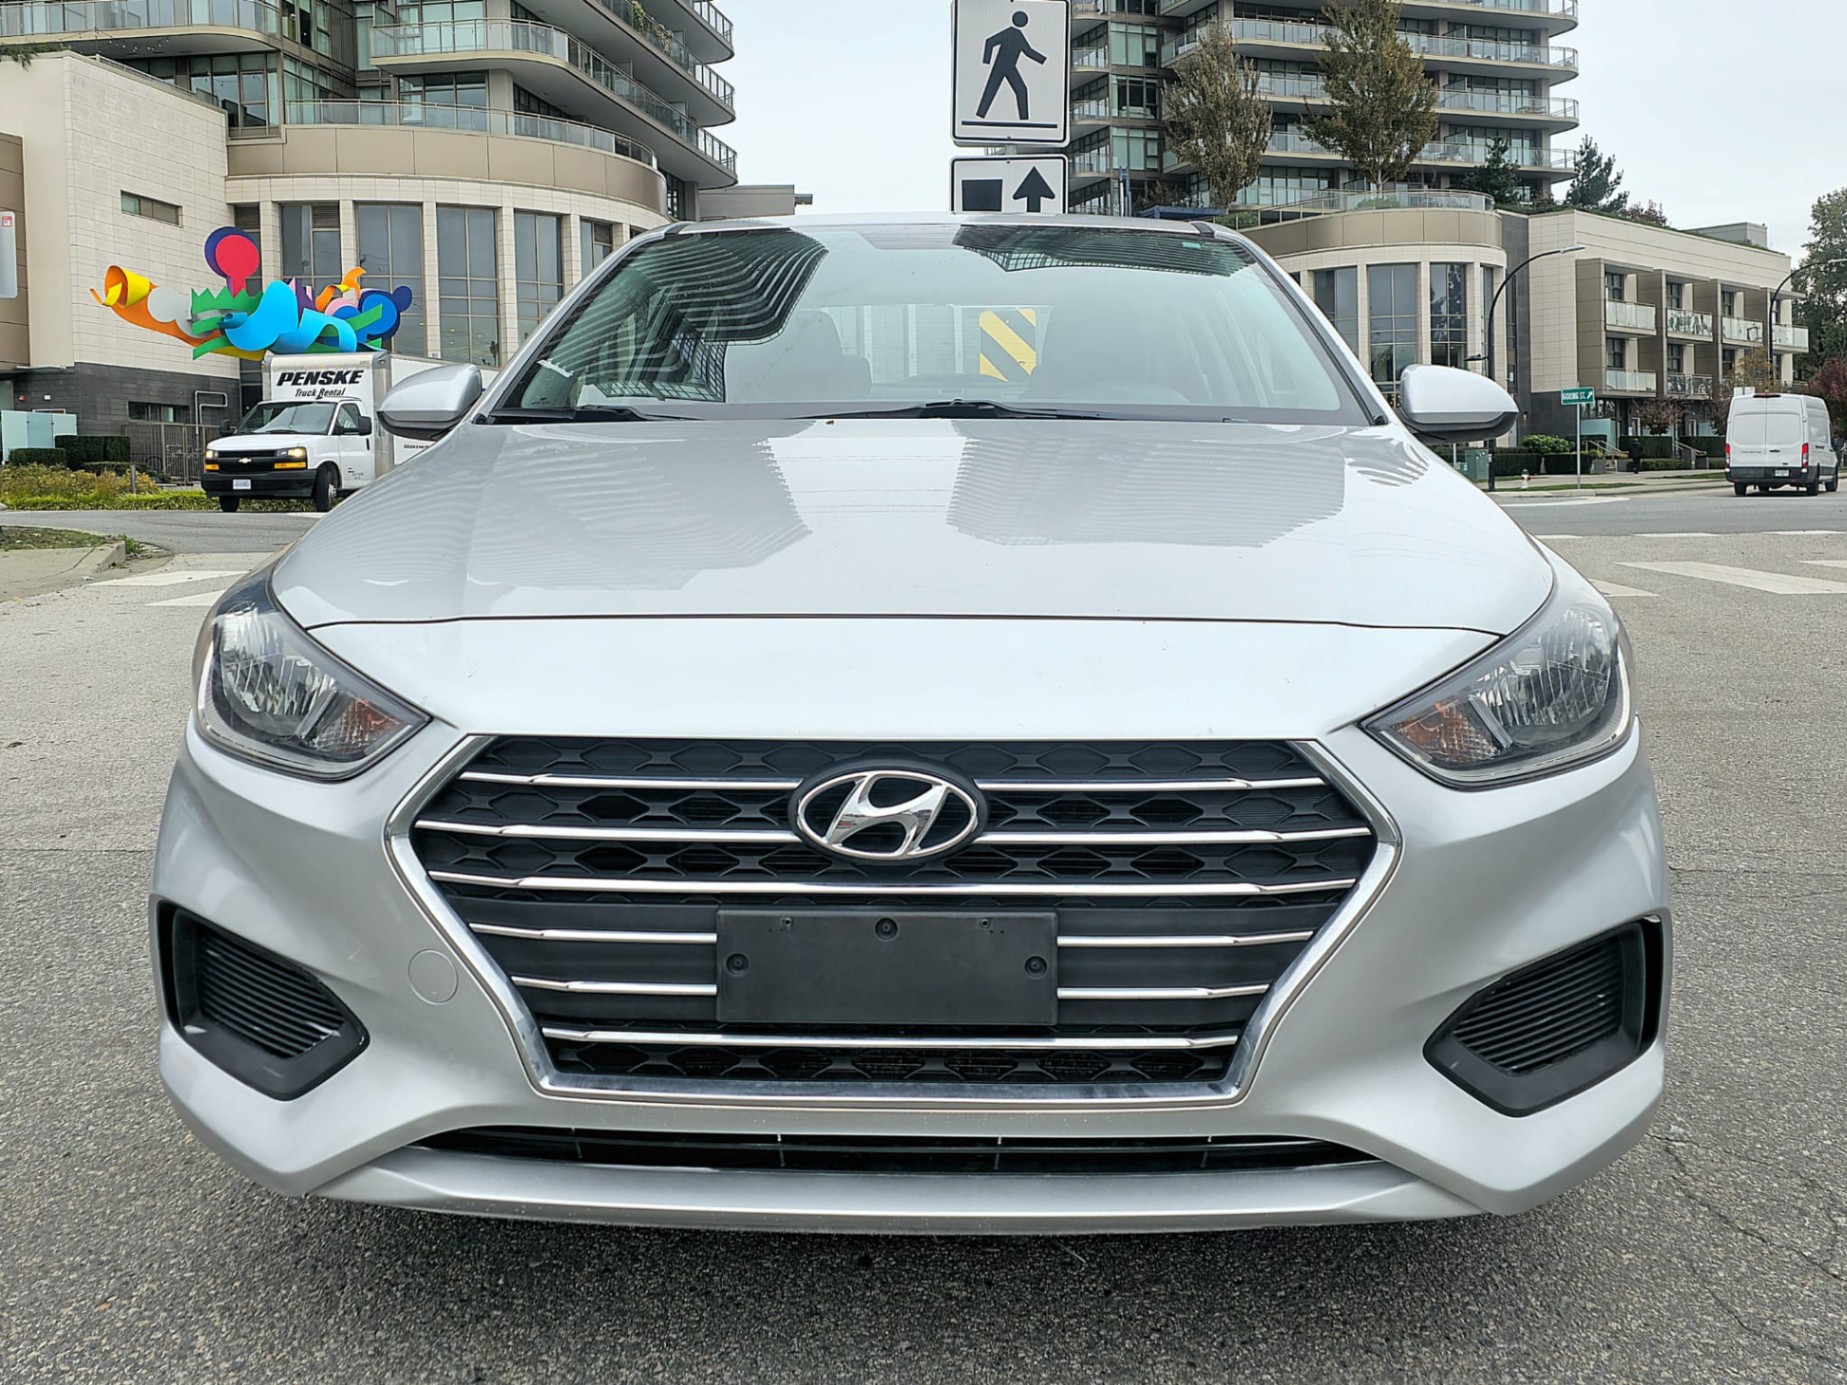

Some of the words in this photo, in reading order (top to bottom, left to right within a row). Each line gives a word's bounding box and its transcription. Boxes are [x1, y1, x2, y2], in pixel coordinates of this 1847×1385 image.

[276, 370, 364, 386] PENSKE
[295, 388, 316, 397] Truck
[315, 387, 346, 400] Rental
